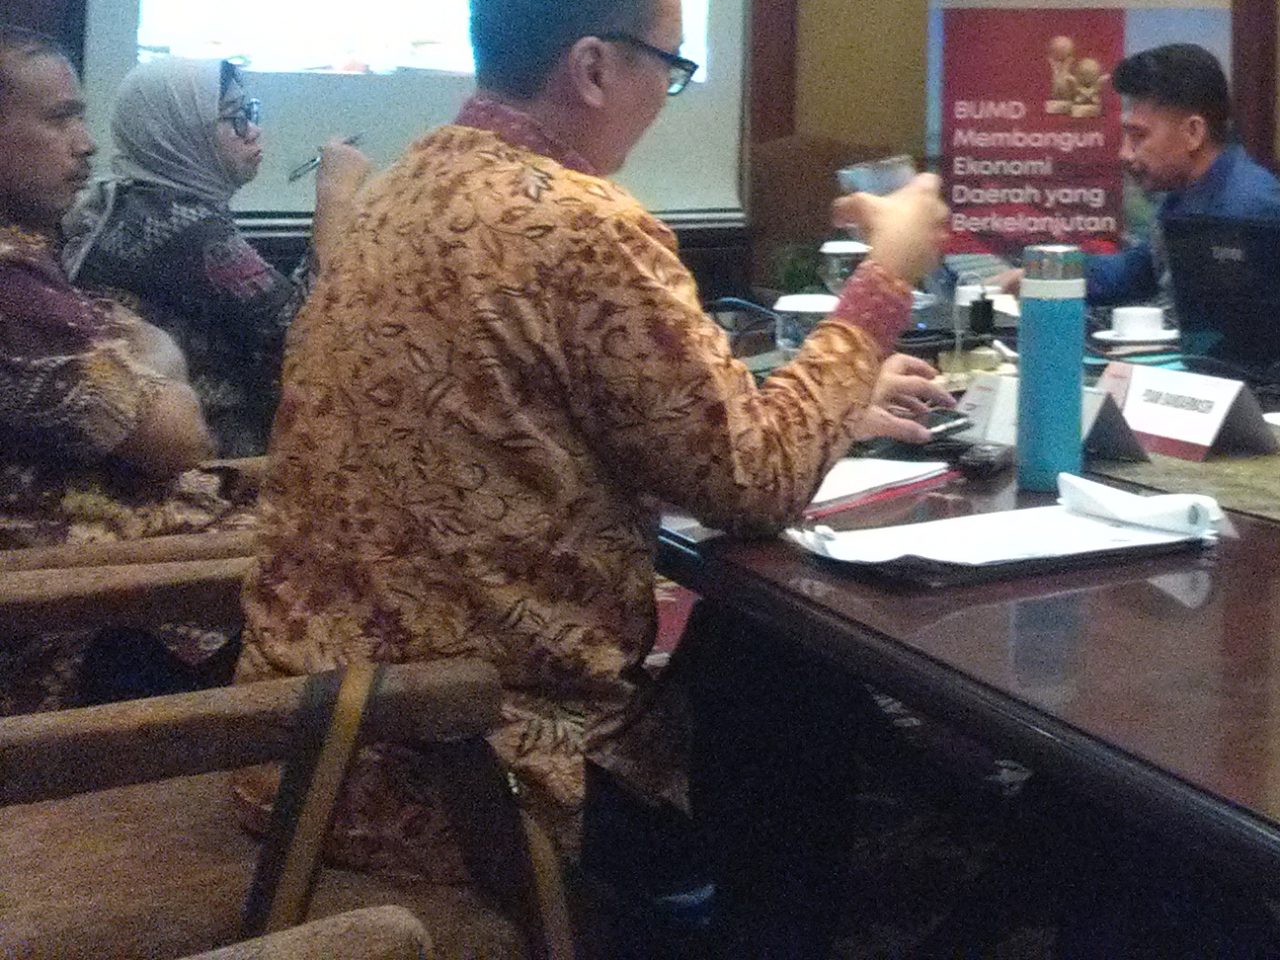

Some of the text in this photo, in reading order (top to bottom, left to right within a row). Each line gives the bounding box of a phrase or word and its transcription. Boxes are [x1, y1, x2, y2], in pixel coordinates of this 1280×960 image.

[954, 100, 1026, 119] BUMD
[953, 127, 1104, 152] Membangun
[953, 156, 1052, 175] Ekonomi
[952, 185, 1105, 208] Daerah yang
[952, 212, 1117, 236] Berkelanjutan
